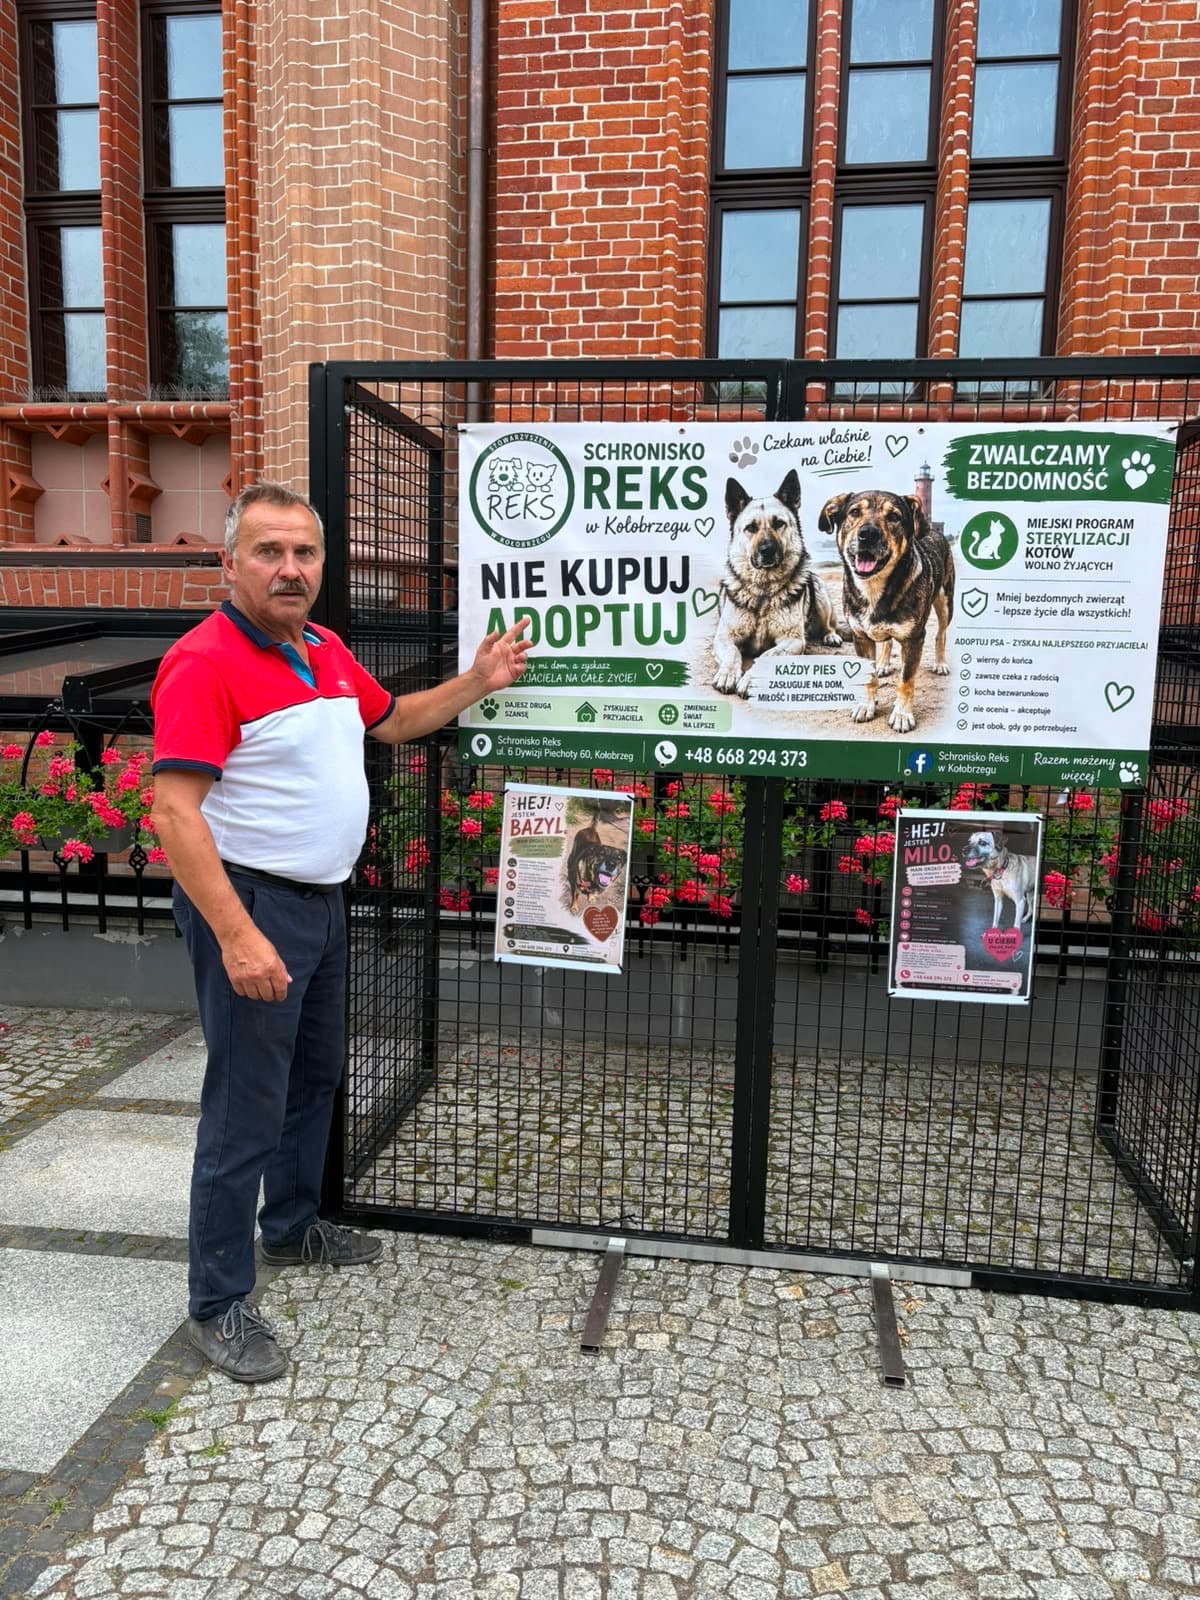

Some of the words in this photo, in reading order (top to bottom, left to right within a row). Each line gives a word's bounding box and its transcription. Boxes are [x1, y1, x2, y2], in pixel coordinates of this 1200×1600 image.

[489, 433, 556, 451] STOWARZYSZENIE
[763, 432, 815, 451] Czekam
[819, 428, 871, 444] właśnie
[584, 443, 705, 460] SCHRONISKO
[801, 456, 818, 466] na
[824, 446, 872, 465] Ciebie!
[969, 445, 1110, 466] ZWALCZAMY
[967, 468, 1109, 490] BEZDOMNOŚĆ
[584, 466, 708, 510] REKS
[488, 494, 556, 520] REKS
[586, 524, 599, 533] w
[605, 516, 690, 540] Kołobrzegu
[1027, 519, 1072, 529] MIEJSKI
[1076, 519, 1134, 529] PROGRAM
[500, 533, 551, 547] KOŁOBRZEGU
[1026, 532, 1130, 546] STERYLIZACJI
[1026, 545, 1074, 558] KOTÓW
[1025, 561, 1061, 570] WOLNO
[1063, 561, 1113, 572] ŻYJĄCYCH
[481, 561, 547, 600] NIE
[560, 556, 690, 596] KUPUJ
[996, 592, 1021, 603] Mniej
[1025, 593, 1083, 604] bezdomnych
[1086, 594, 1125, 604] zwierząt
[1003, 607, 1031, 617] lepsze
[1034, 607, 1057, 618] życie
[1060, 607, 1074, 616] dla
[1078, 608, 1131, 618] wszystkich!
[486, 602, 686, 648] ADOPTUJ
[1013, 640, 1040, 648] ZYSKAJ
[1042, 640, 1094, 648] NAJLEPSZEGO
[1096, 641, 1148, 650] PRZYJACIELA!
[551, 660, 569, 670] dom,
[581, 660, 610, 672] zyskasz
[775, 662, 810, 676] KAŻDY
[813, 665, 836, 675] PIES
[566, 673, 577, 682] NA
[580, 672, 604, 683] CAŁE
[608, 671, 636, 683] ŻYCIE!
[825, 681, 844, 689] DOM,
[758, 692, 784, 702] MIŁOŚĆ
[792, 692, 856, 702] BEZPIECZEŃSTWO.
[505, 701, 528, 709] DAJESZ
[530, 702, 551, 710] DRUGĄ
[1017, 707, 1050, 715] akceptuje
[505, 710, 528, 719] SZANSĘ
[603, 714, 643, 722] PRZYJACIELA
[972, 722, 984, 730] jest
[1033, 724, 1076, 733] potrzebujesz
[498, 736, 540, 746] Schronisko
[543, 737, 561, 746] Reks
[515, 748, 542, 758] Dywizji
[544, 748, 577, 760] Piechoty
[580, 750, 592, 759] 60,
[594, 751, 634, 762] Kołobrzeg
[685, 748, 712, 764] +48
[717, 748, 744, 765] 668
[748, 748, 776, 766] 294
[780, 750, 807, 767] 373
[938, 752, 986, 762] Schronisko
[988, 753, 1008, 763] Reks
[1034, 752, 1070, 765] Razem
[1073, 756, 1115, 770] możemy
[948, 765, 996, 775] Kołobrzegu
[1061, 771, 1101, 785] więcej!
[518, 796, 551, 810] HEJ!
[912, 822, 945, 838] HEJ!
[904, 844, 951, 864] MILO
